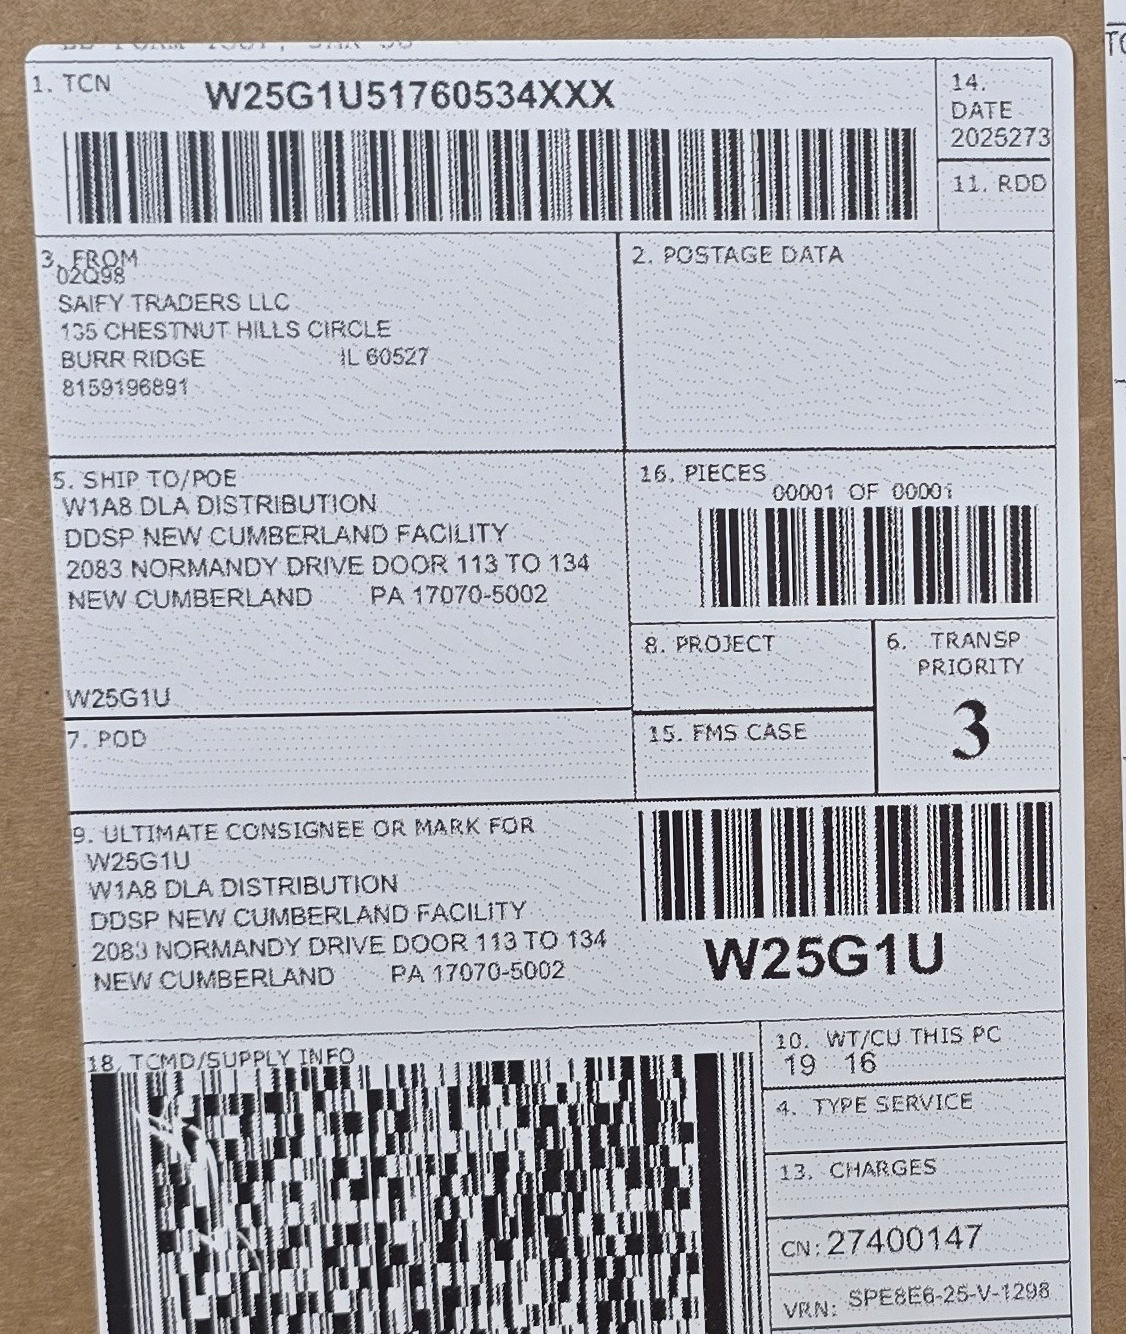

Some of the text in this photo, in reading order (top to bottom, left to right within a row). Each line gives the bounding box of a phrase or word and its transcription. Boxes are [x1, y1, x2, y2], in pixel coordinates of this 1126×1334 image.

[33, 74, 111, 94] 1. TCN
[952, 73, 986, 91] 14.
[206, 81, 614, 111] W25G1U51760534XXX
[951, 101, 1012, 120] DATE
[950, 128, 1051, 148] 2025273
[953, 174, 1046, 192] 11. RDD
[73, 249, 138, 268] FROM
[632, 246, 844, 265] 2. POSTAGE DATA
[56, 267, 126, 285] 02Q98
[59, 292, 290, 313] SAIFY TRADERS LLC
[62, 350, 125, 369] BURR
[133, 349, 205, 368] RIDGE
[366, 346, 430, 366] 60527
[62, 378, 188, 398] 8159196891
[53, 469, 236, 490] 5. SHIP TO/POE
[641, 464, 766, 483] 16. PIECES
[772, 484, 834, 500] 00001
[849, 484, 879, 499] OF
[63, 493, 378, 516] W1A8 DLA DISTRIBUTION
[65, 522, 509, 548] DDSP NEW CUMBERLAND FACILITY
[67, 553, 589, 580] 2083 NORMANDY DRIVE DOOR 113 TO 134
[68, 584, 548, 610] NEW CUMBERLAND PA 17070-5002
[644, 635, 775, 653] 8. PROJECT
[887, 632, 1021, 651] 6. TRANSP
[918, 658, 1024, 676] PRIORITY
[67, 688, 171, 709] W25G1U
[68, 730, 147, 749] 7. POD
[649, 723, 807, 743] 15. FMS CASE
[952, 699, 990, 760] 3
[73, 816, 534, 845] 9. ULTIMATE CONSIGNEE OR MARK FOR
[87, 851, 191, 873] W25G1U
[704, 932, 945, 981] W25G1U
[776, 1026, 1002, 1049] 10. WT/CU THIS PC
[784, 1051, 878, 1076] 19 16
[815, 1096, 868, 1115] TYPE
[876, 1092, 973, 1113] SERVICE
[829, 1159, 937, 1178] CHARGES
[781, 1224, 984, 1258] CN: 27400147
[782, 1301, 837, 1318] VRN:
